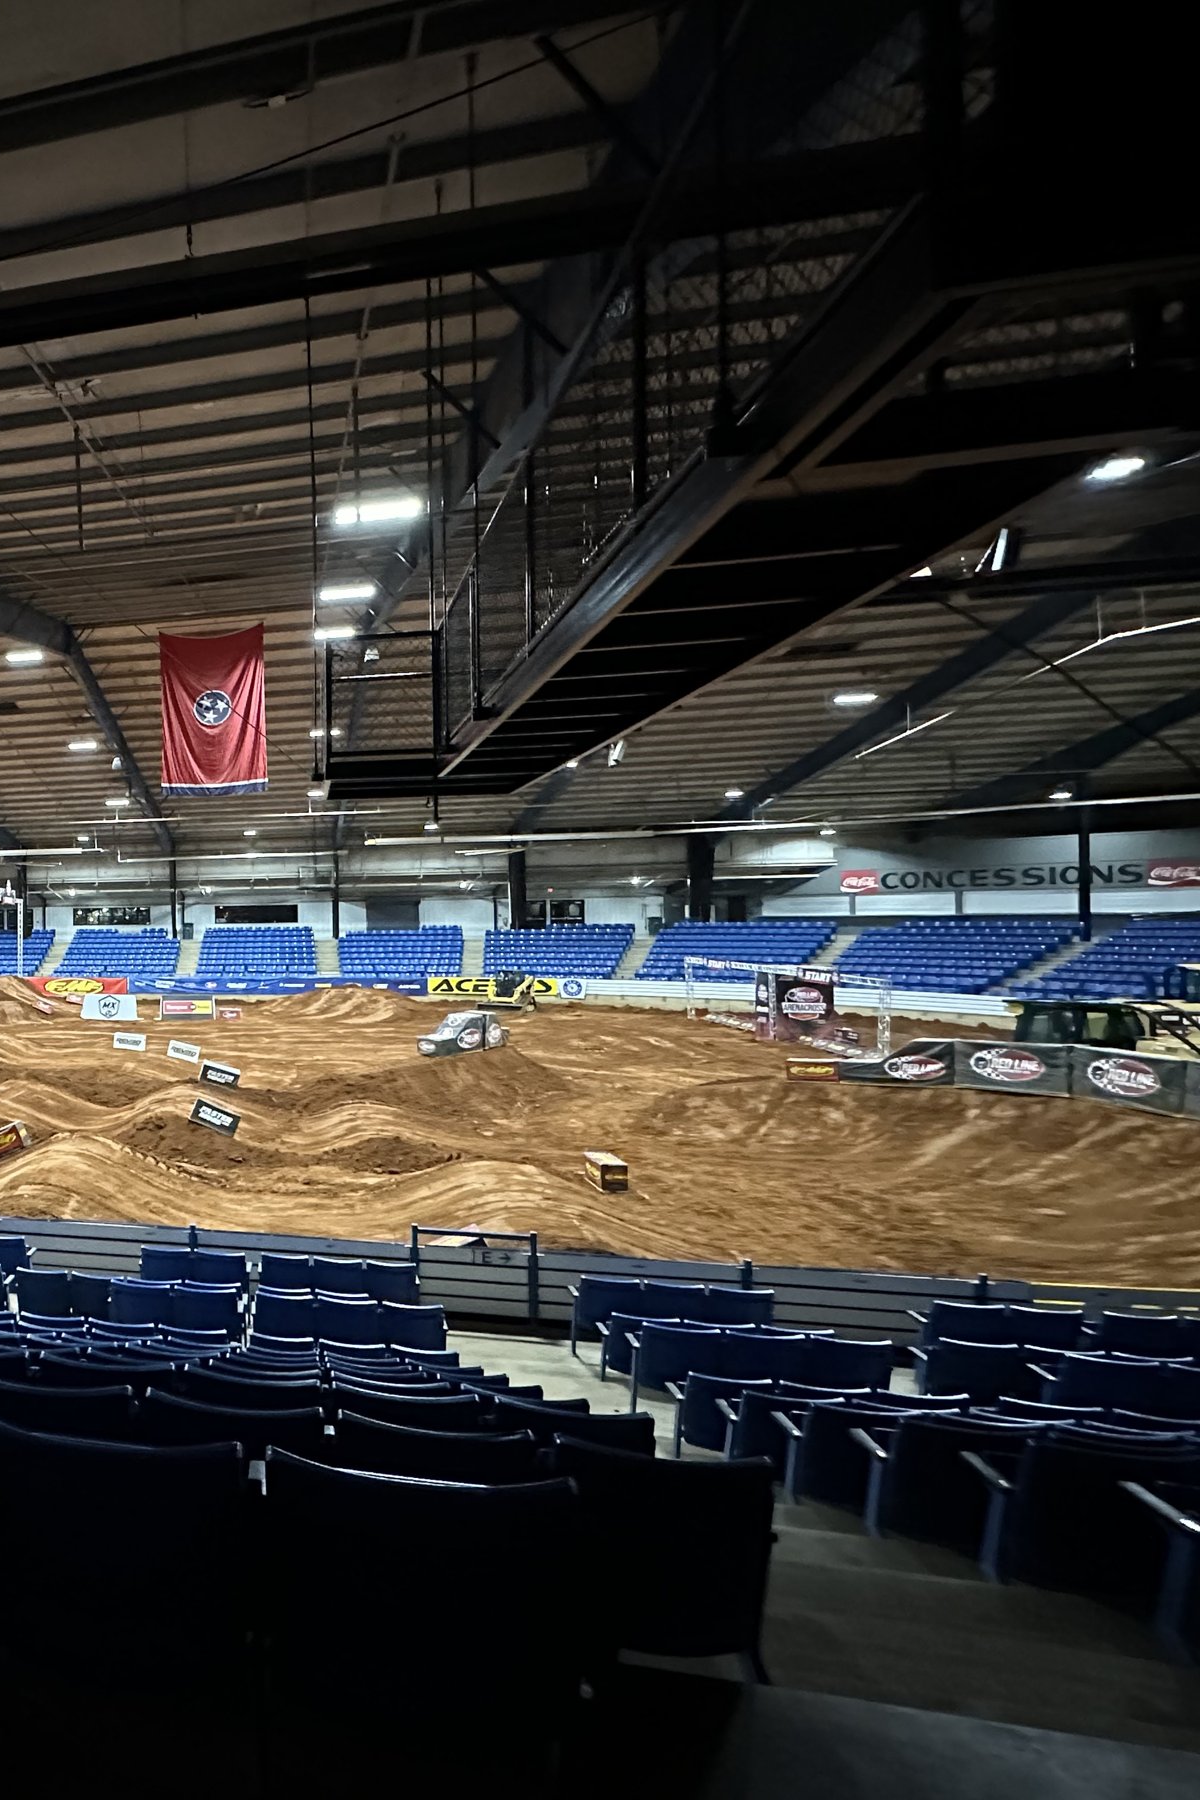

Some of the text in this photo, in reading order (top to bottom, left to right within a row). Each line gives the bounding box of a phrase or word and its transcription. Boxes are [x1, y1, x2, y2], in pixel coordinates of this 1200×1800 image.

[881, 864, 1143, 890] CONCESSIONS
[804, 971, 831, 982] START
[45, 979, 103, 992] FMF
